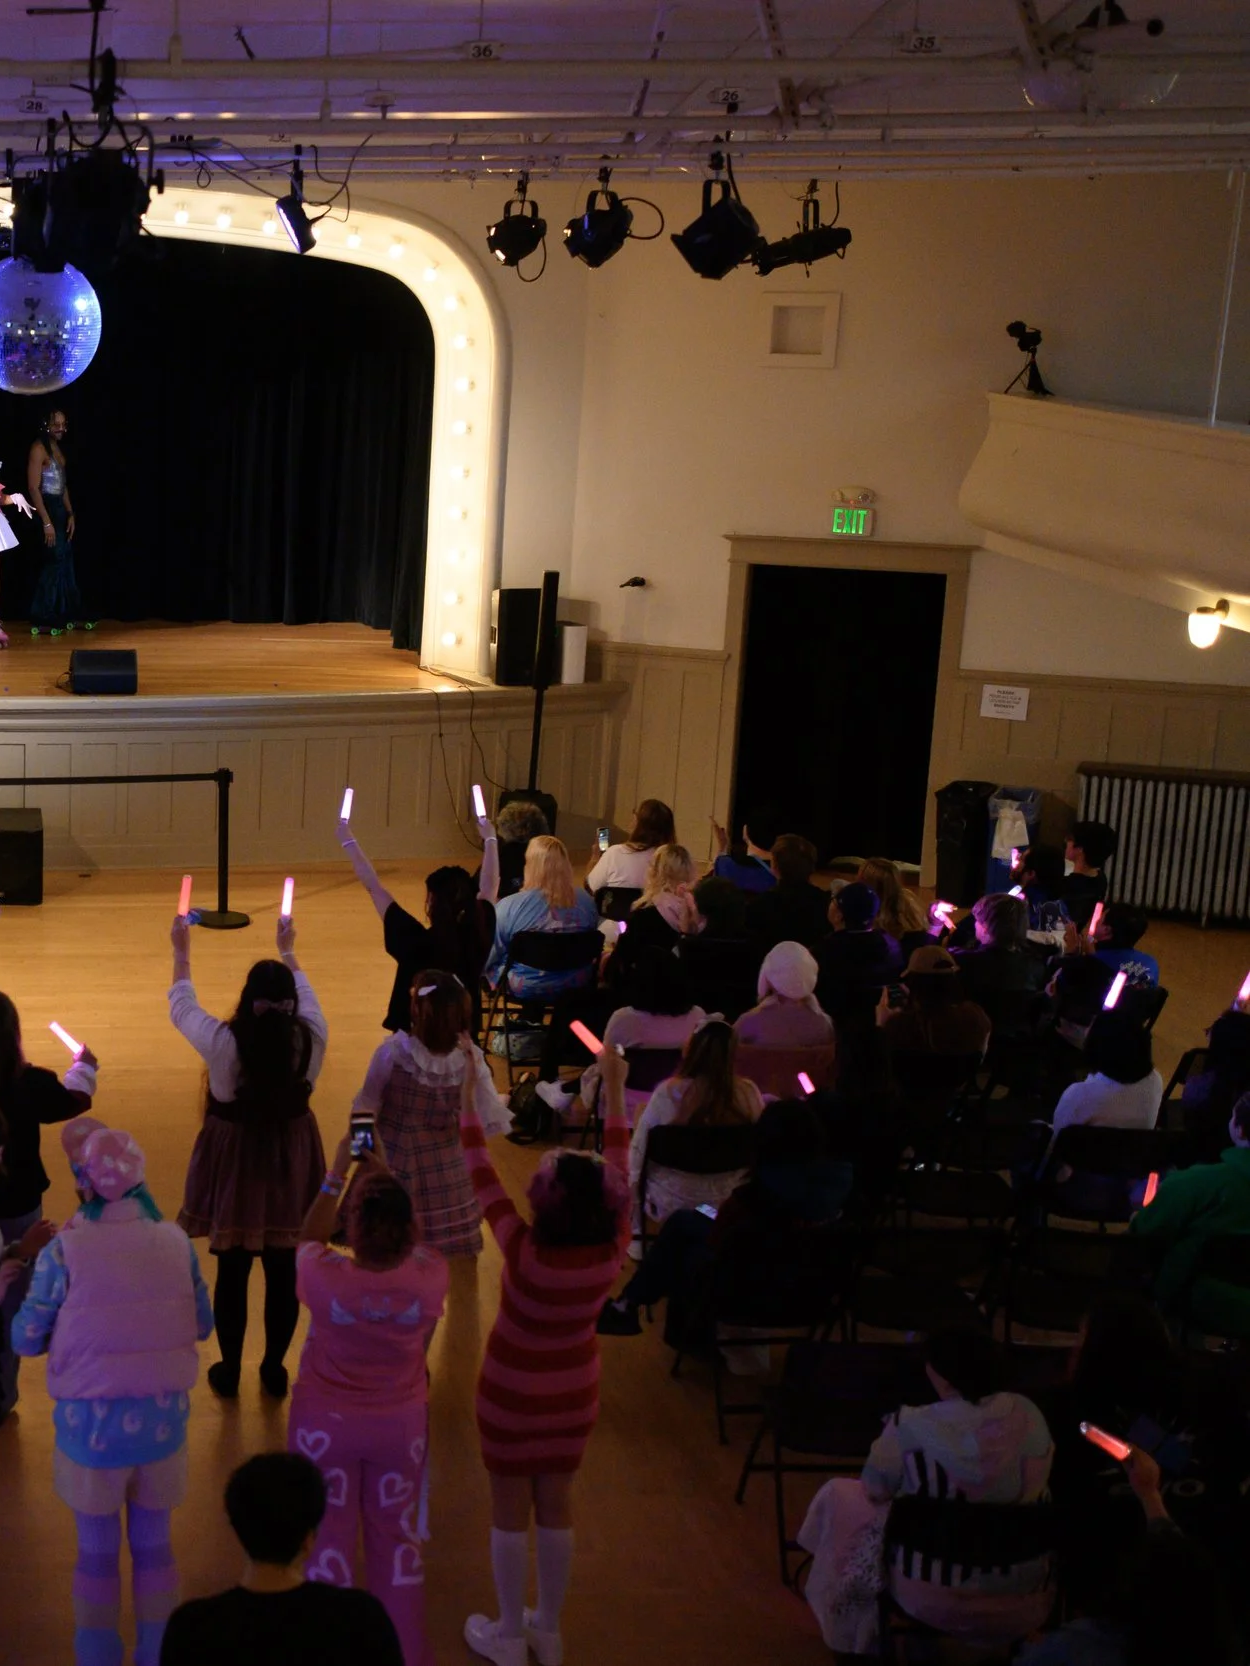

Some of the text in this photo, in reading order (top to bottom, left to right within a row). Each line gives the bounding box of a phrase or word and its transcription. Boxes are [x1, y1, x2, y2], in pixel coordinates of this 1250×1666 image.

[914, 36, 936, 49] 35
[472, 45, 493, 58] 36
[721, 91, 739, 101] 26
[26, 100, 43, 110] 28
[832, 508, 868, 534] EXIT
